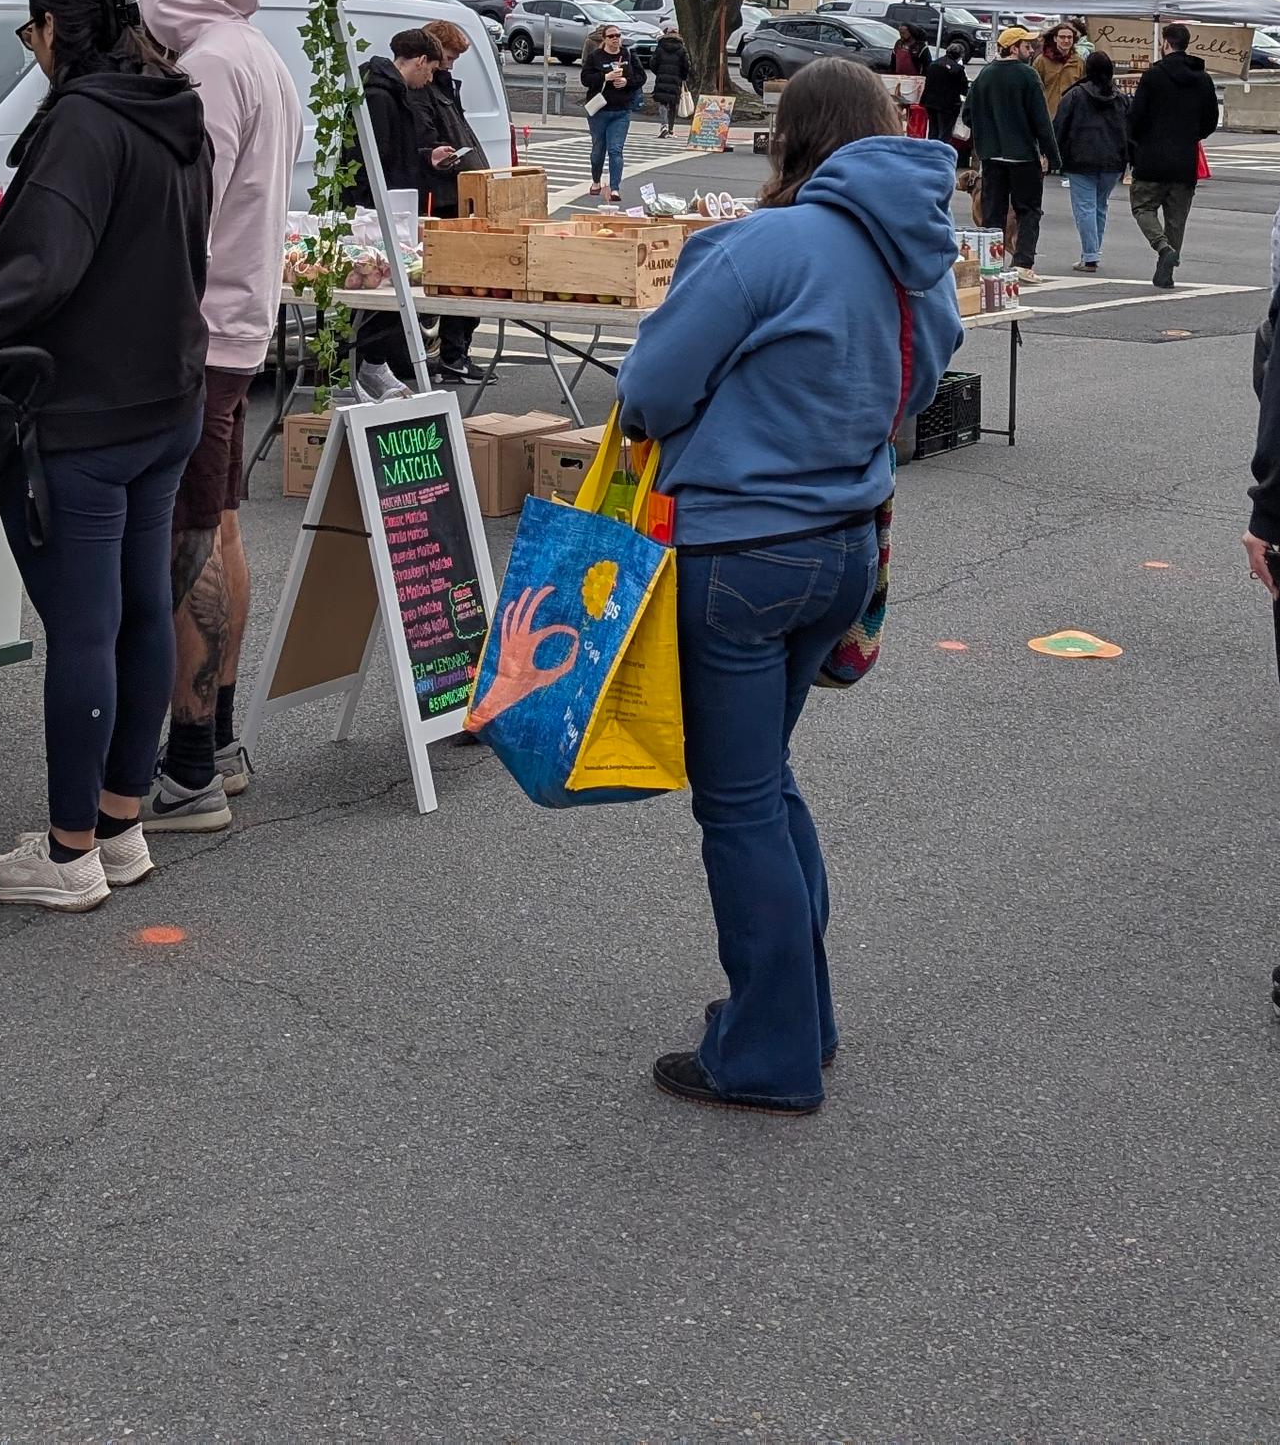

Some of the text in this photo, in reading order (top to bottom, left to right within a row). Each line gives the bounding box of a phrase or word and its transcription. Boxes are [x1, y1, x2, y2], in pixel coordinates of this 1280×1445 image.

[1094, 25, 1154, 45] Ram
[376, 428, 427, 459] MUCHO
[382, 454, 443, 487] MATCHA
